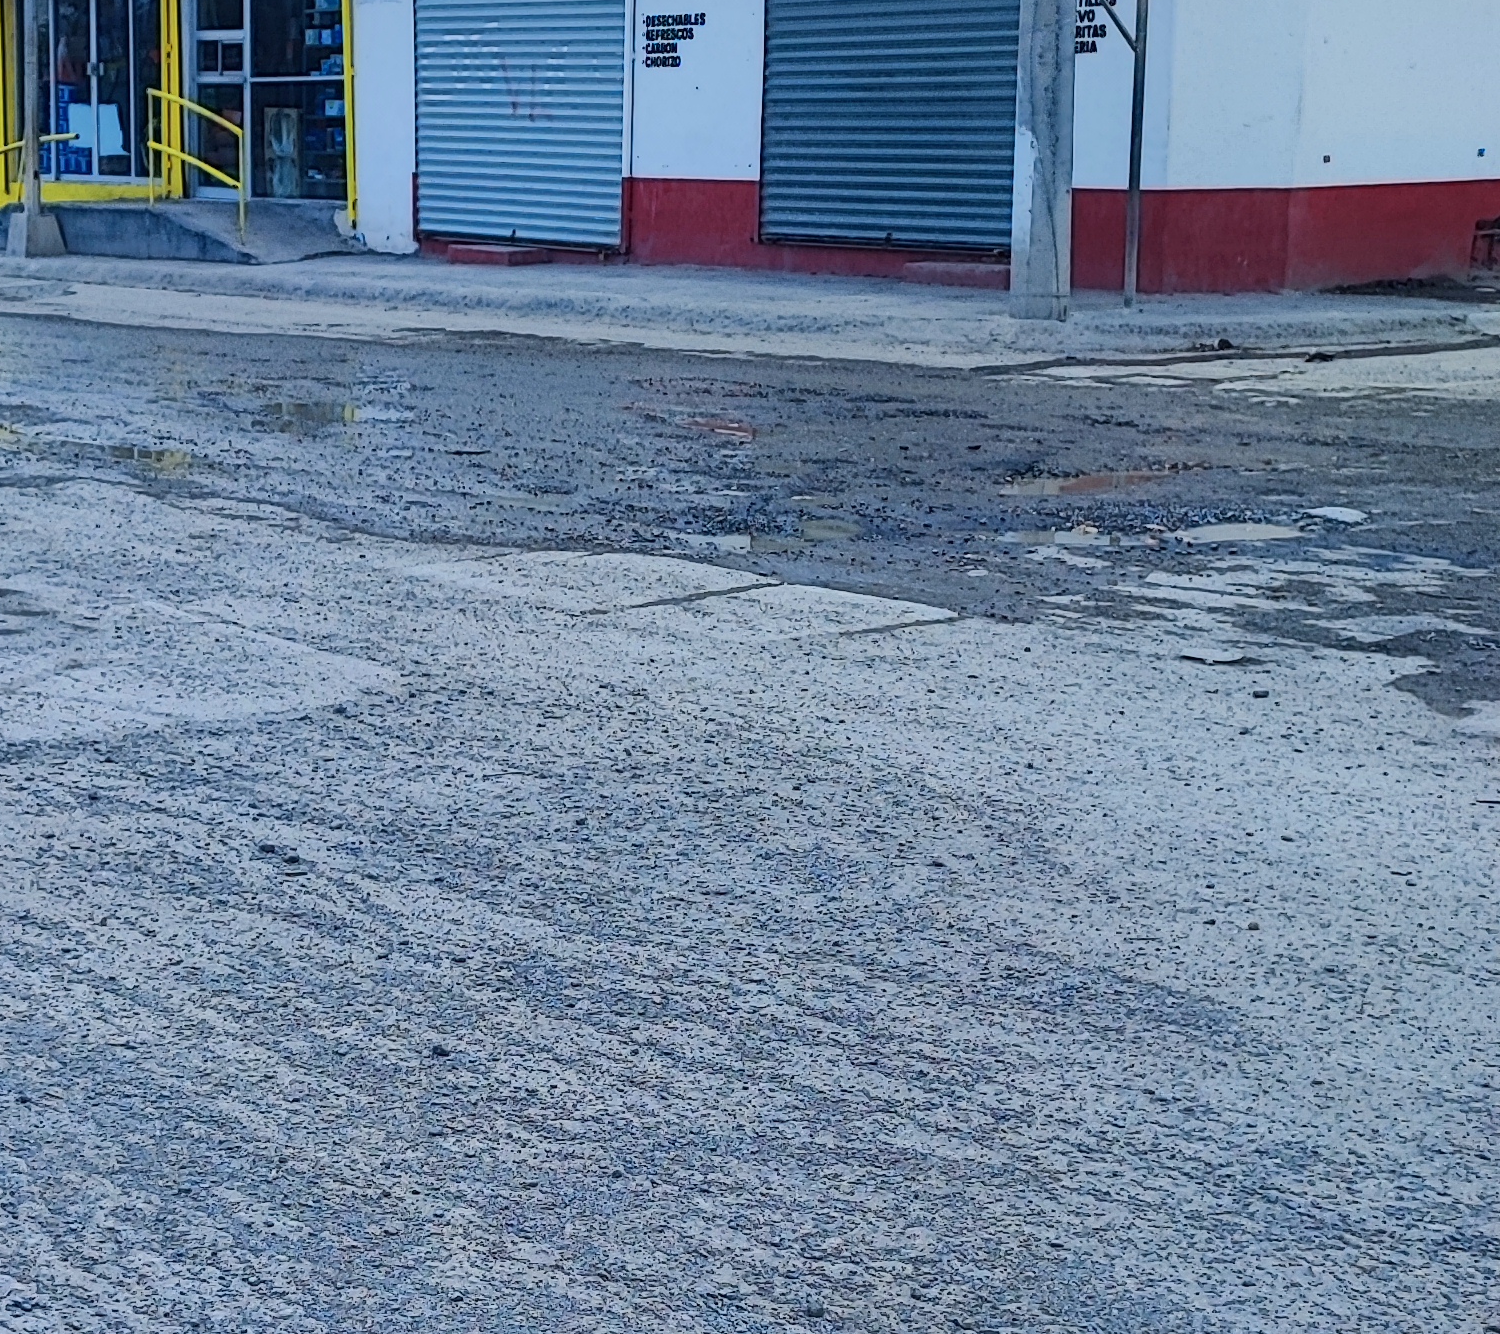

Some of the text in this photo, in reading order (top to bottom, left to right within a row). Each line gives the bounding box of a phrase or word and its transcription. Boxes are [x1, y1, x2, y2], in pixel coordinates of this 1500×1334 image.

[645, 12, 706, 27] DESECHABLES
[645, 27, 695, 41] REFRESCOS
[645, 55, 682, 68] CHORIZO
